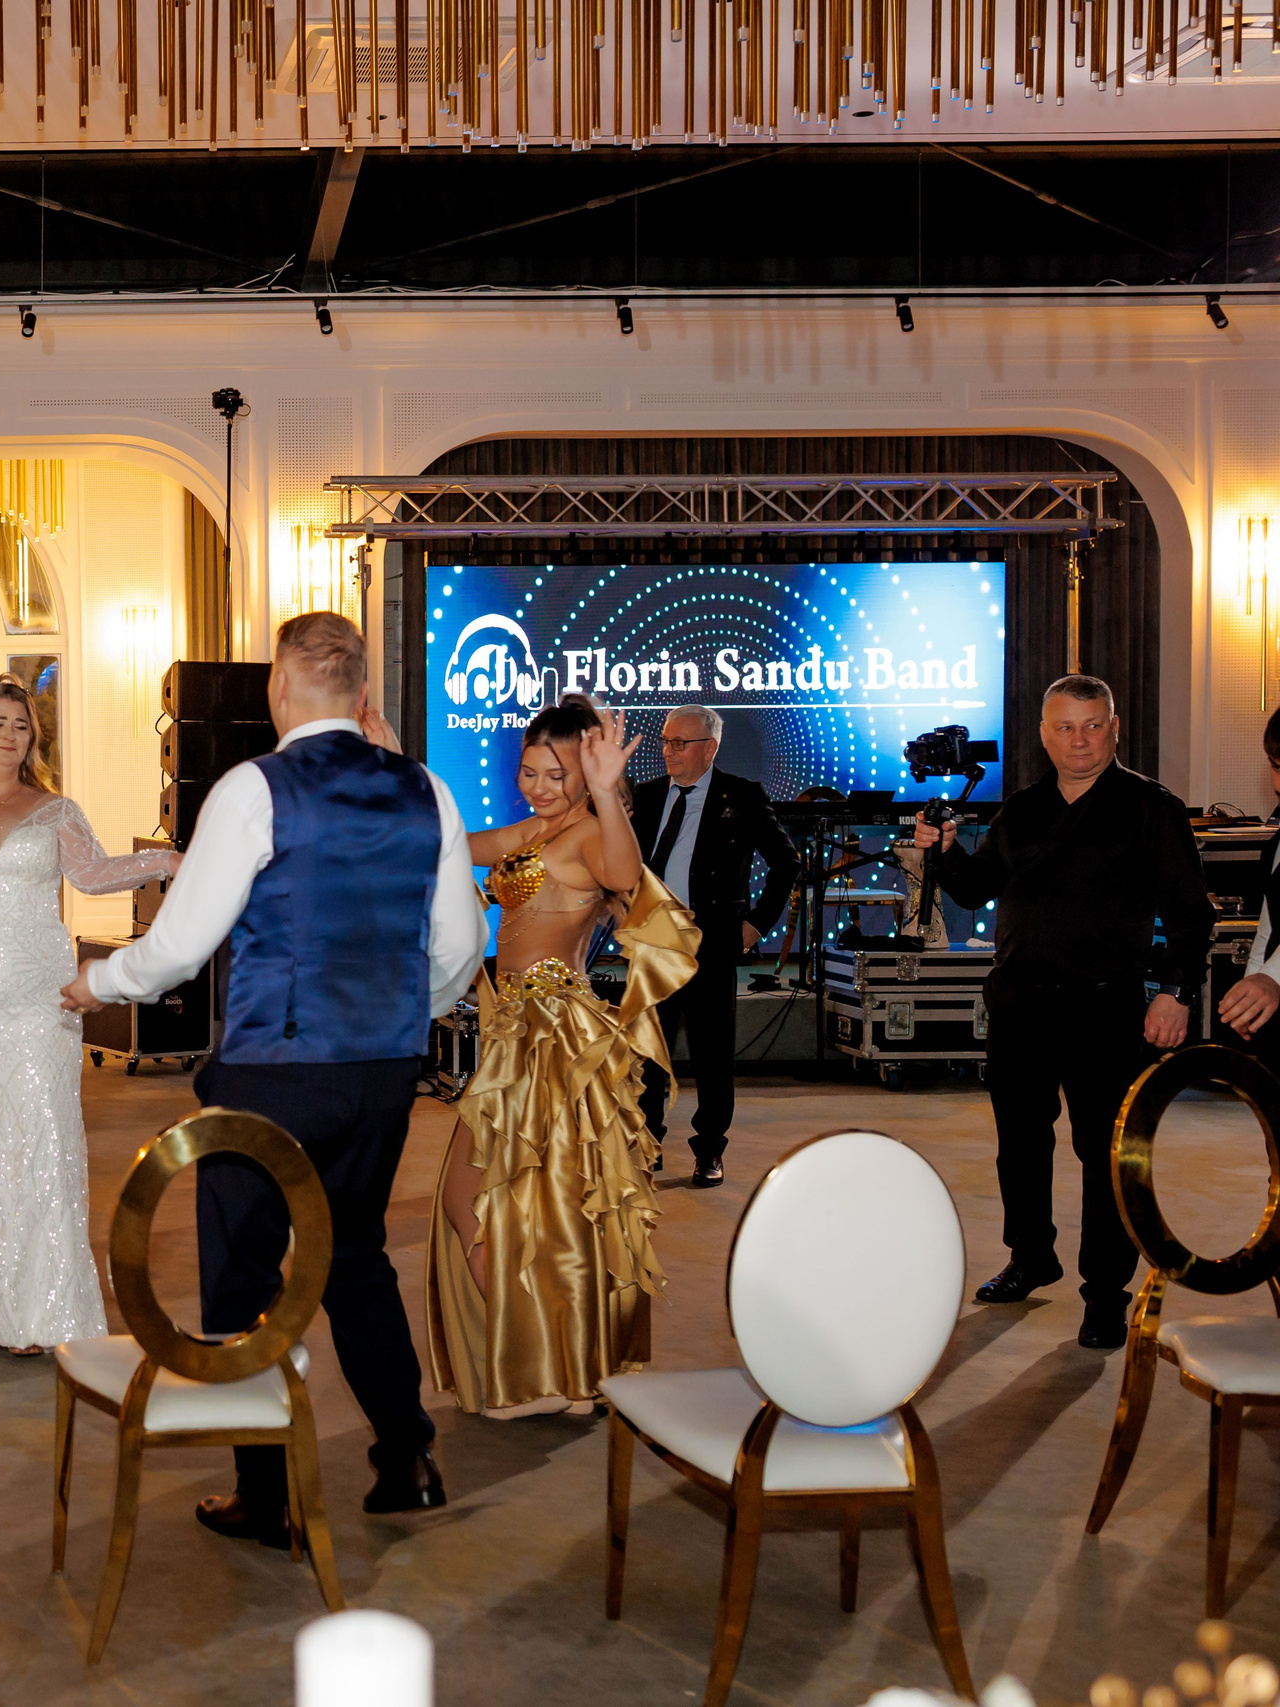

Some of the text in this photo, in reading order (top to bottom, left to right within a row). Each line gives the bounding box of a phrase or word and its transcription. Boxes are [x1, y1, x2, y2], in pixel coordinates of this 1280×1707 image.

[562, 645, 979, 692] Florin Sandu Band
[446, 713, 500, 733] DeeJay
